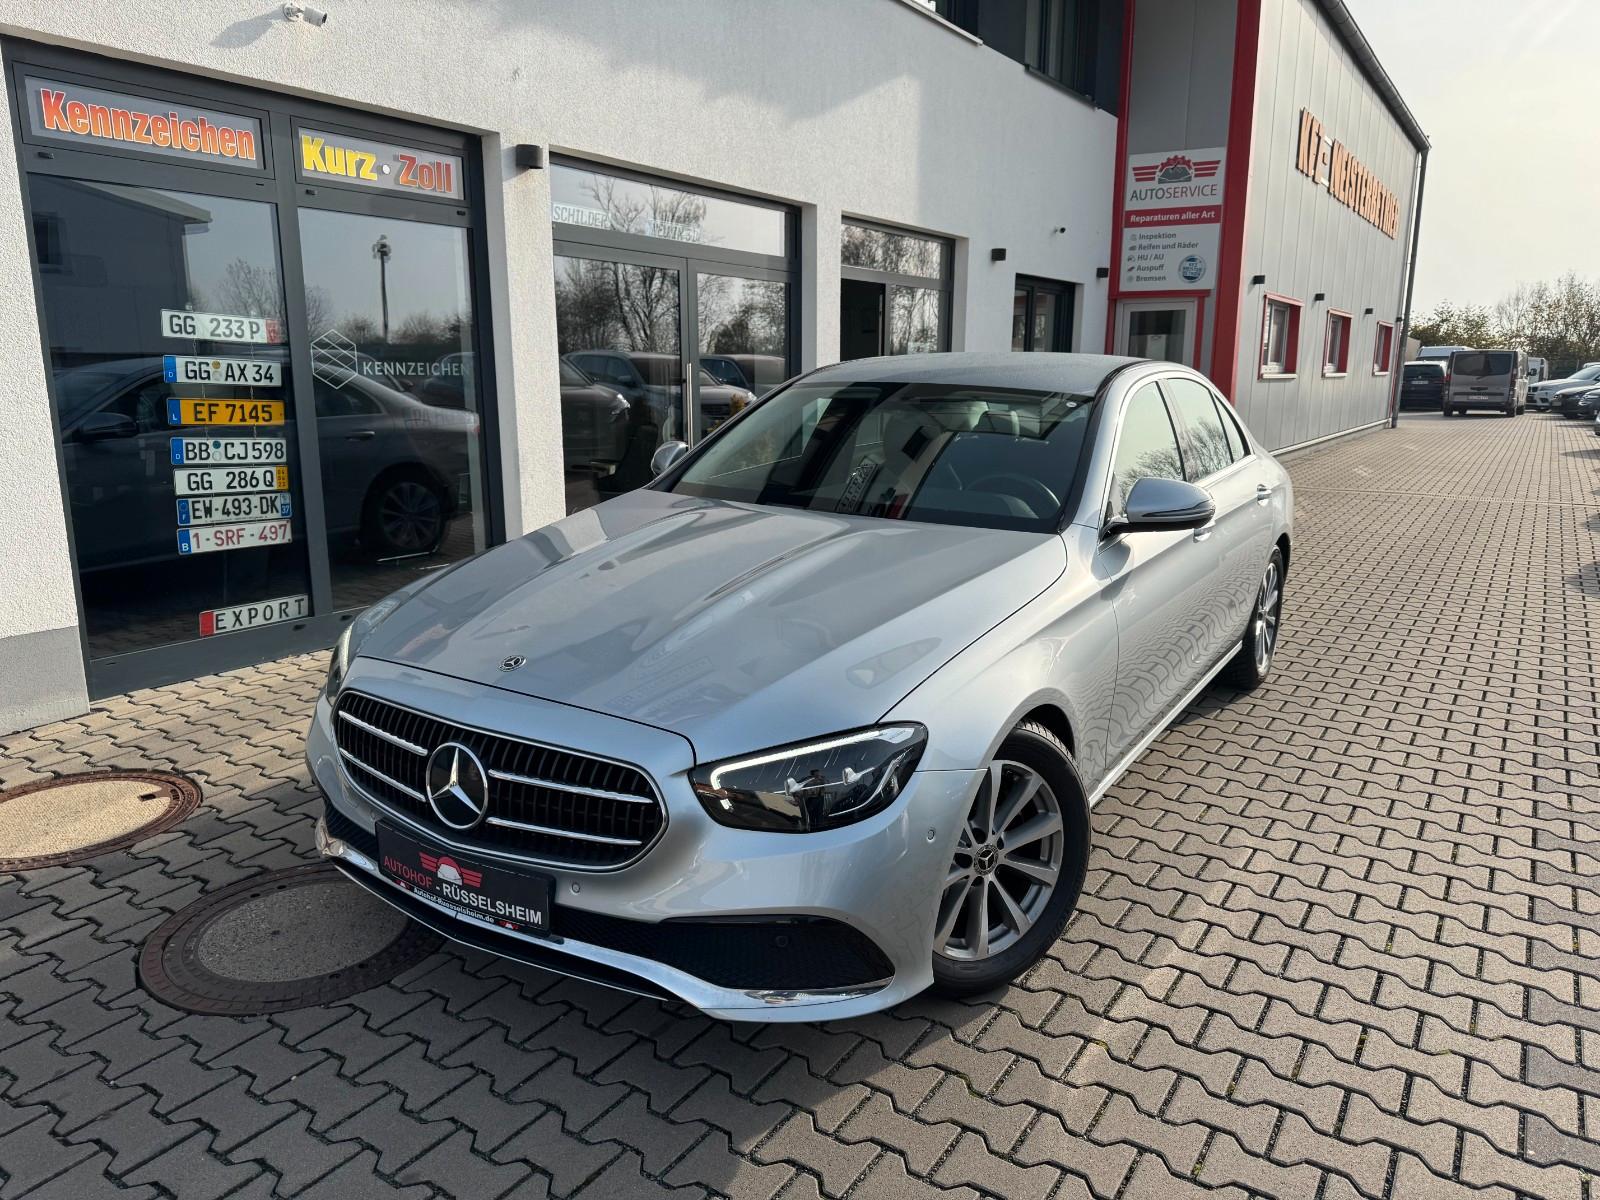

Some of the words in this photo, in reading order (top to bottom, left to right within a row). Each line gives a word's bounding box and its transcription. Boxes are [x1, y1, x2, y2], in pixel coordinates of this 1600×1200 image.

[40, 88, 256, 160] Kennzeichen
[302, 134, 378, 181] Kurz
[399, 153, 453, 193] Zoll
[1129, 184, 1218, 201] AUTOSERVICE
[553, 206, 609, 229] SCHILDER
[1130, 213, 1180, 224] Reparaturen
[1181, 211, 1200, 220] aller
[1201, 210, 1216, 218] Art
[1138, 243, 1160, 251] Reifen
[1177, 241, 1199, 249] Räder
[1139, 232, 1177, 241] Inspektion
[1136, 264, 1165, 272] Auspuff
[169, 314, 196, 335] GG
[209, 318, 245, 339] 233
[185, 361, 211, 381] GG
[363, 362, 471, 376] KENNZEICHEN
[193, 403, 219, 422] EF
[225, 403, 273, 423] 7145
[185, 442, 211, 461] BB
[187, 472, 213, 491] GG
[225, 470, 259, 490] 286
[216, 598, 305, 631] EXPORT
[383, 856, 433, 888] AUTOHOF
[443, 883, 542, 925] RÜSSELSHEIM
